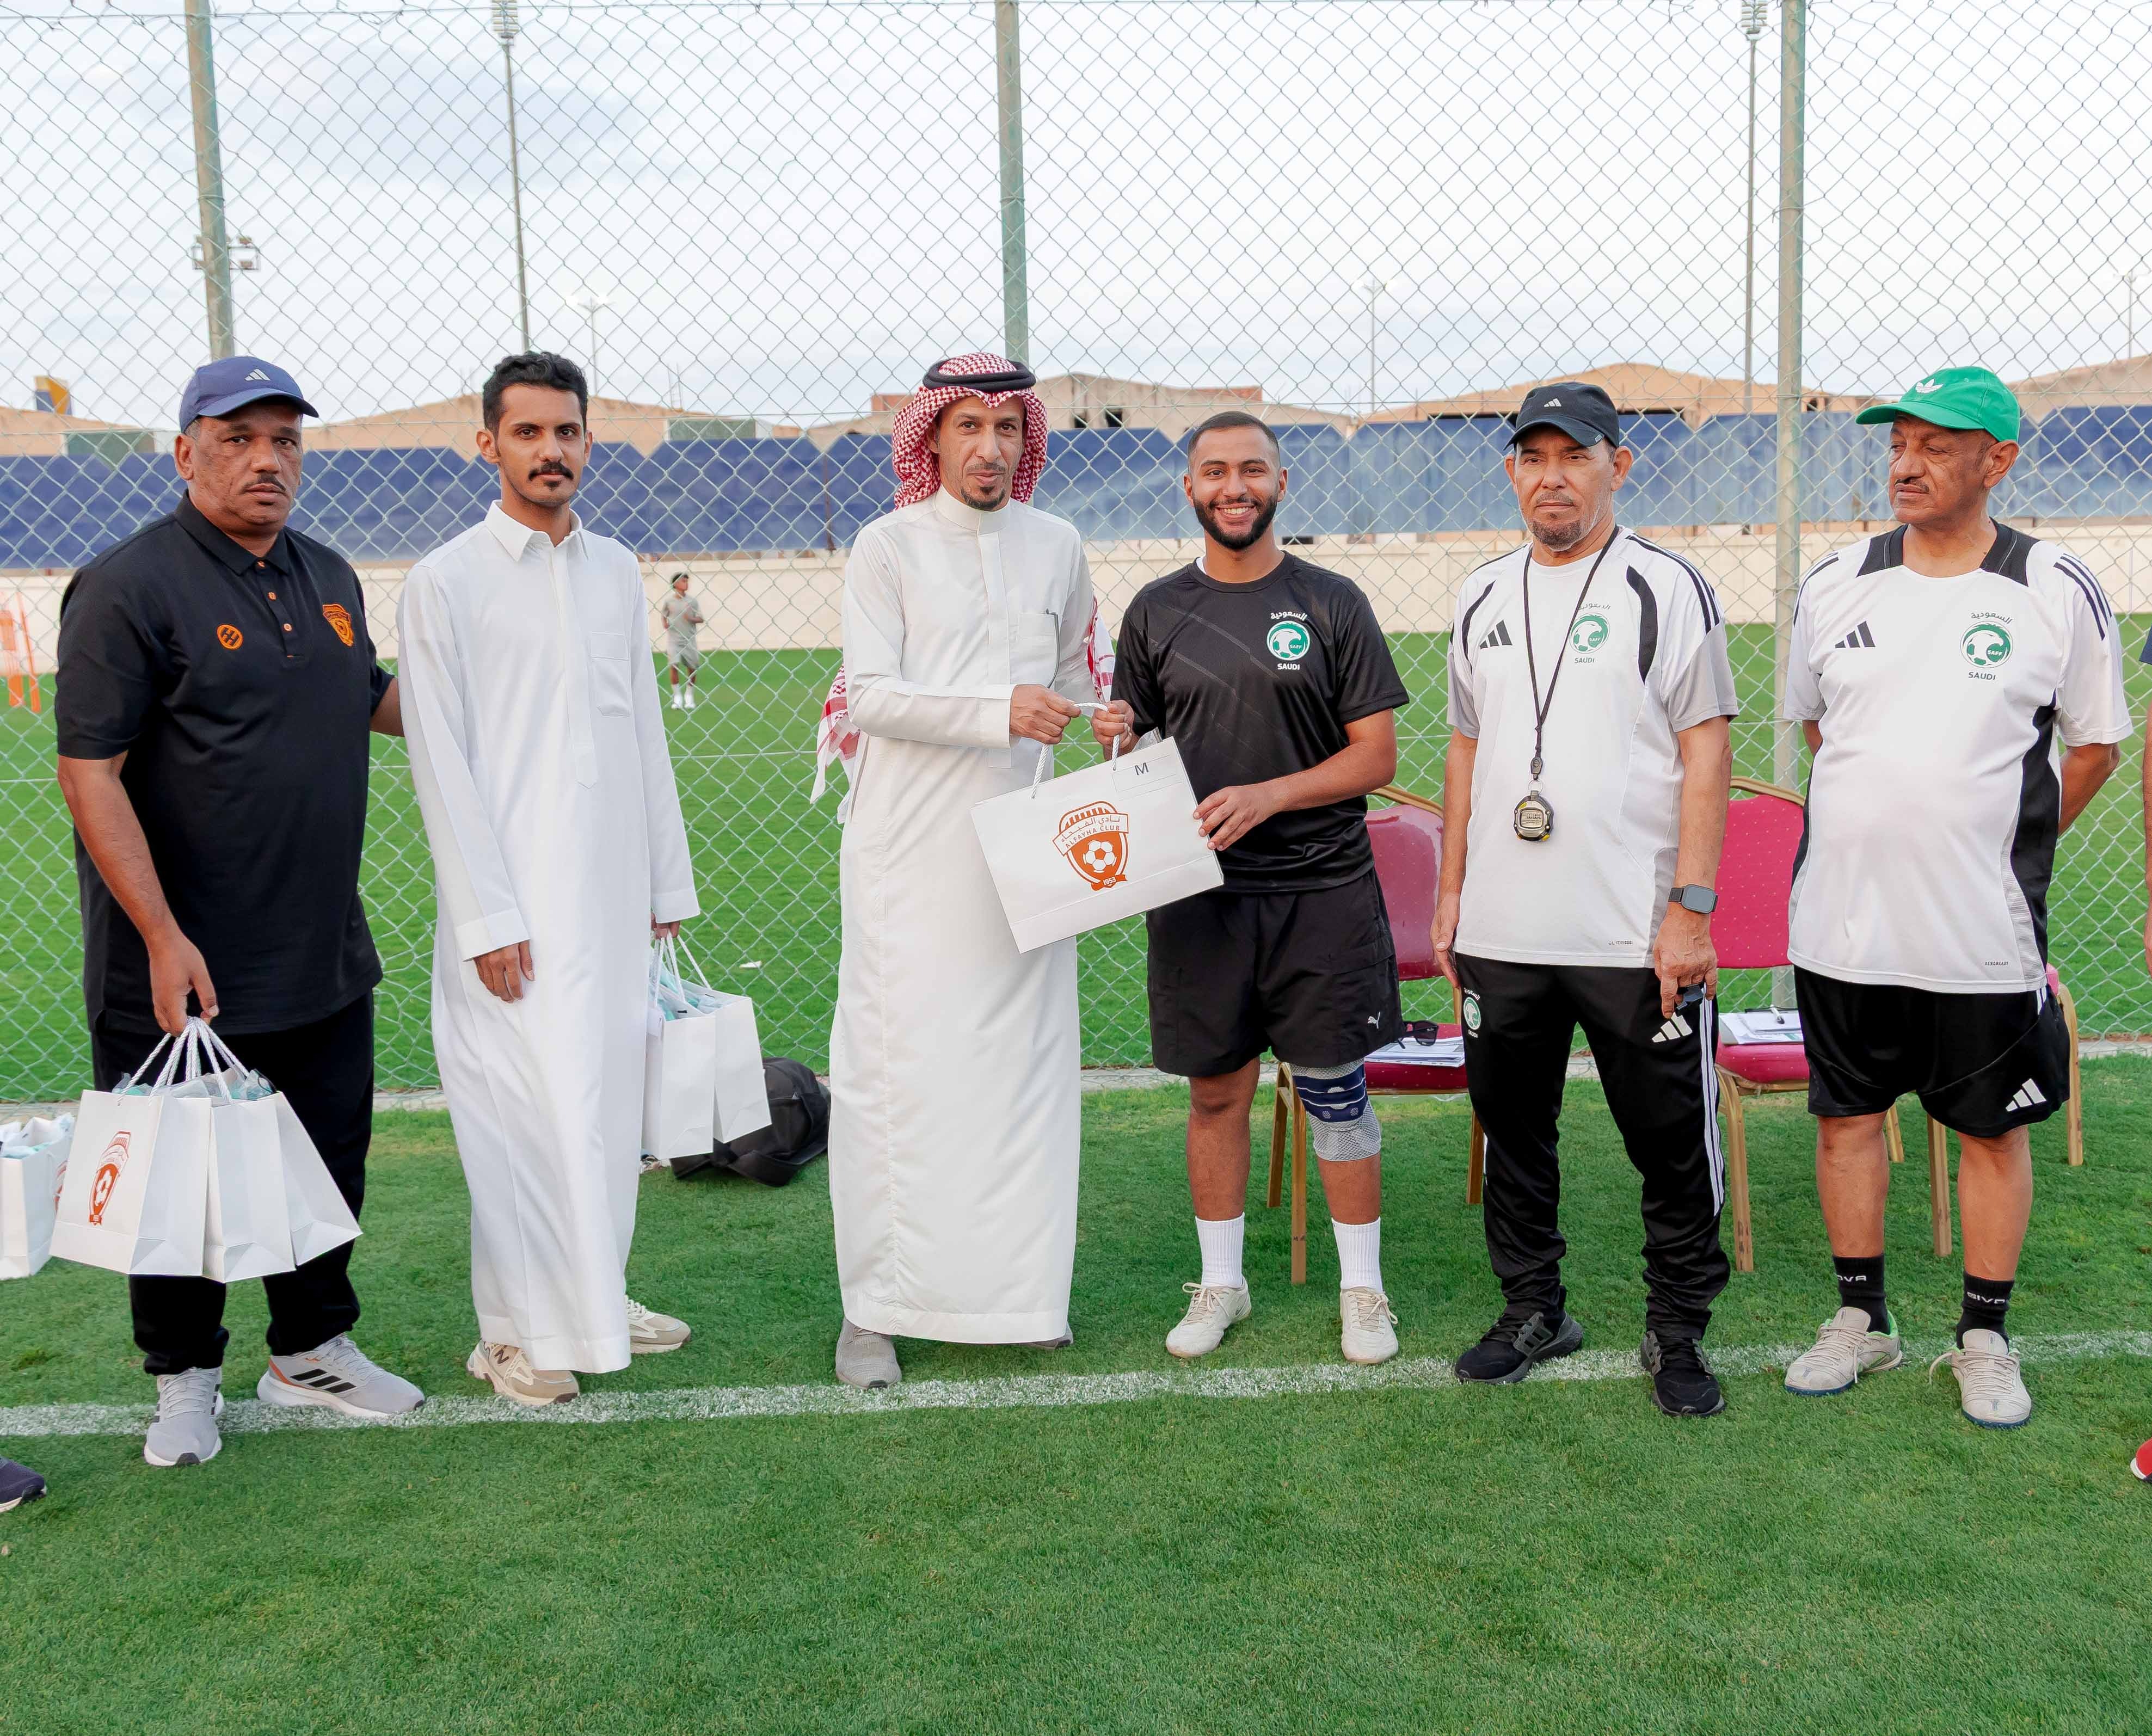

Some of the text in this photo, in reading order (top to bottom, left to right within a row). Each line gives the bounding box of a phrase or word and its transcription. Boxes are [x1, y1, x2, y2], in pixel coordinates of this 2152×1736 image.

[1270, 611, 1307, 621] السعودية
[1971, 612, 2013, 624] السعودية
[1968, 672, 1996, 680] SAUDI
[1135, 762, 1148, 775] M
[1066, 828, 1097, 848] ALFAYHA
[1967, 1291, 2008, 1304] GIVO
